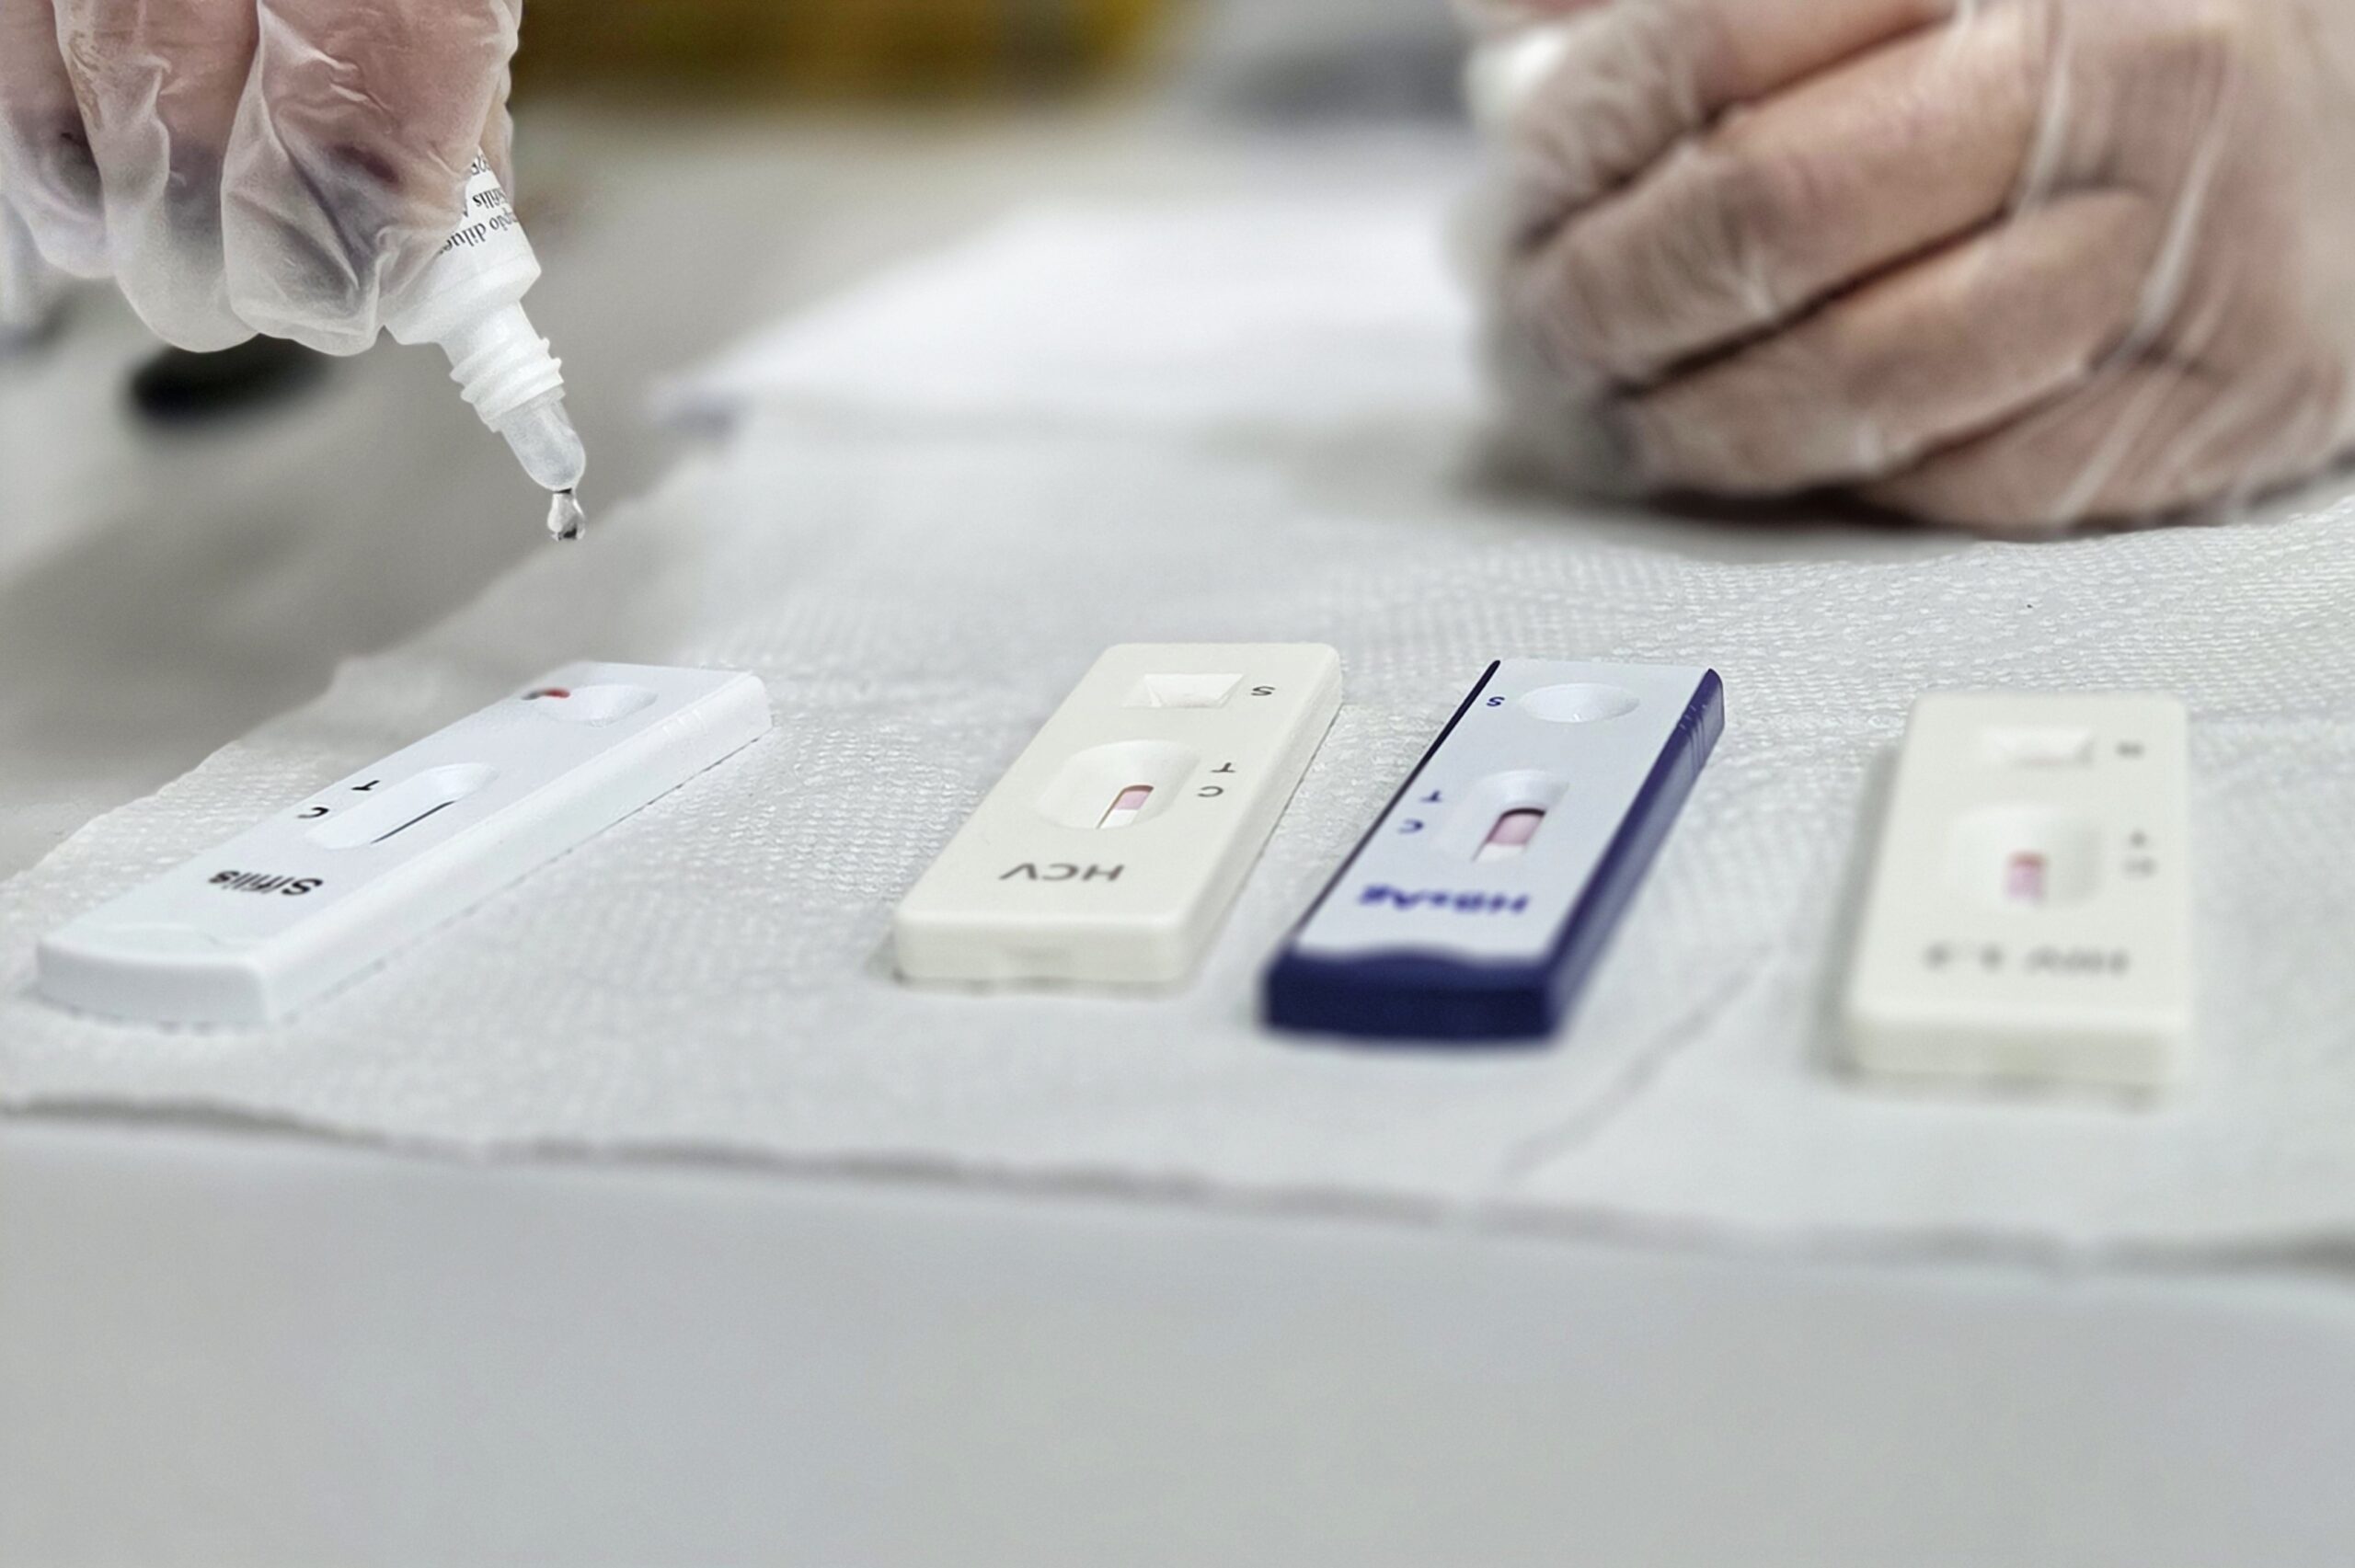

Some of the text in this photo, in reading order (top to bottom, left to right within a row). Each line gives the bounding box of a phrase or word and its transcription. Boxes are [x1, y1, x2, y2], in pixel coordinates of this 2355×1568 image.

[1251, 685, 1276, 697] S
[1487, 695, 1506, 707] S
[1211, 761, 1236, 773] T
[350, 779, 381, 792] T
[1197, 784, 1224, 798] C
[296, 806, 330, 819] C
[1397, 818, 1424, 834] C
[998, 863, 1125, 882] HCV
